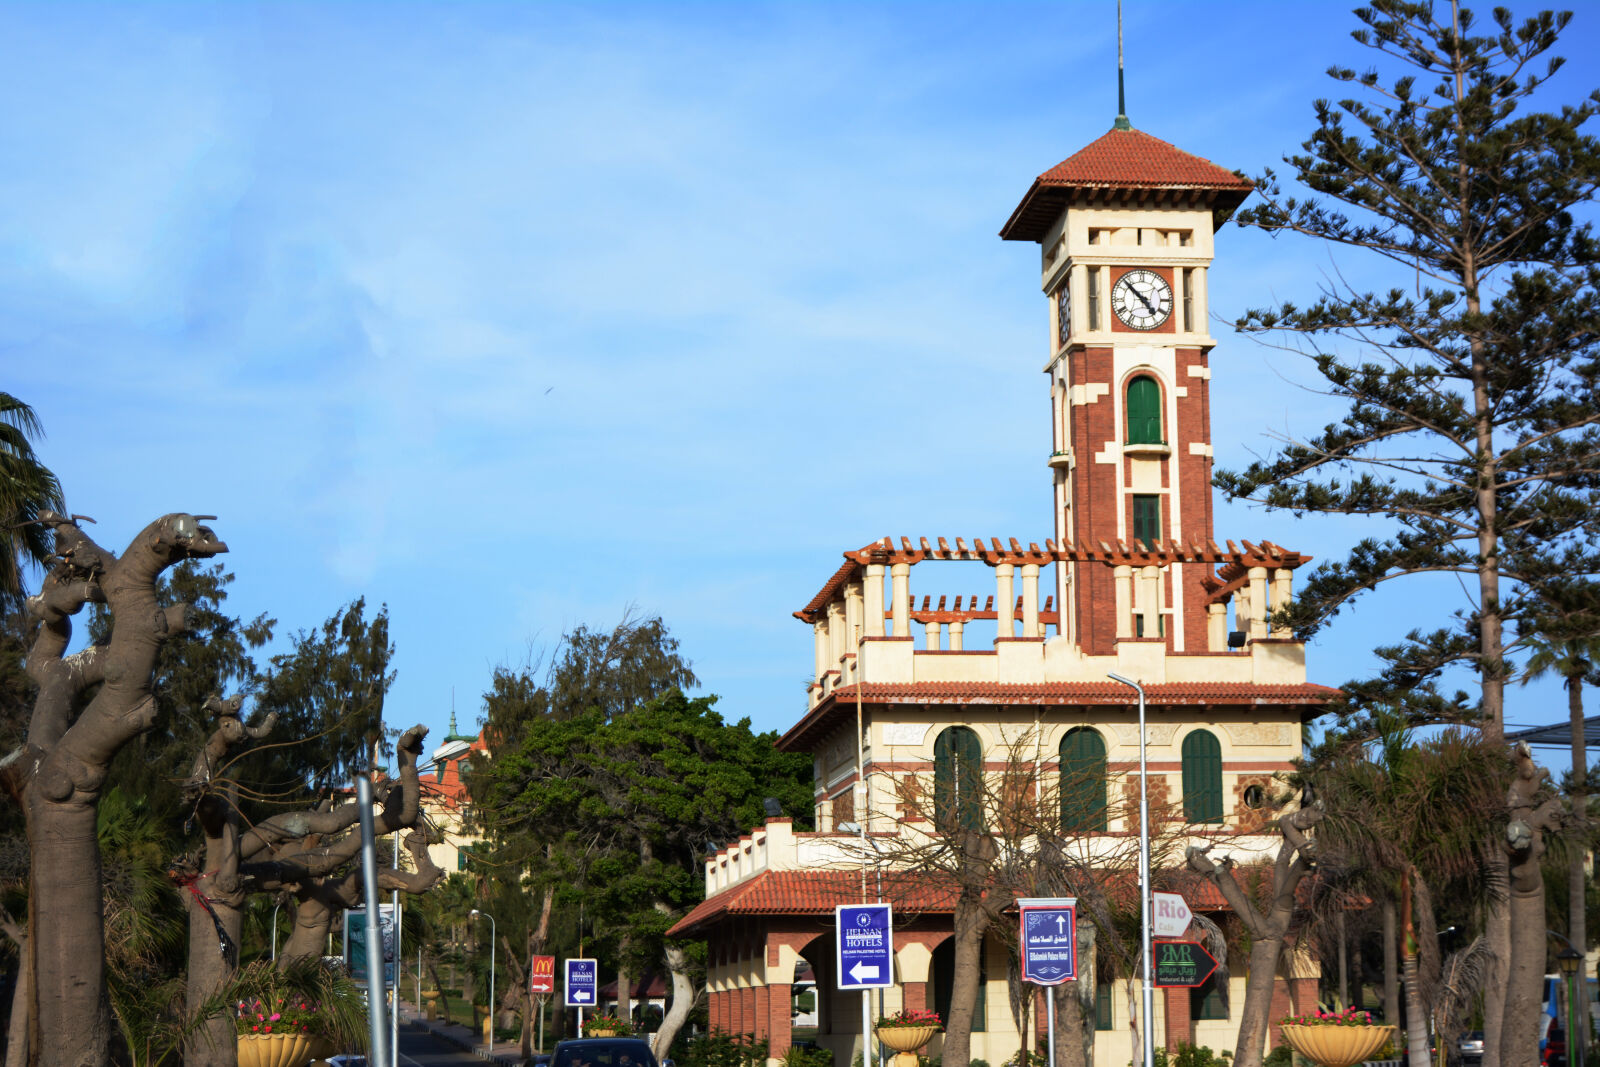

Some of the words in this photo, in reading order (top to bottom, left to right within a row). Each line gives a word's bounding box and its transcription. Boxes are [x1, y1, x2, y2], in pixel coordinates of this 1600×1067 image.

[1158, 900, 1186, 919] Rio
[846, 928, 882, 936] HELNAN
[846, 938, 882, 947] HOTELS
[1053, 934, 1067, 944] فندق
